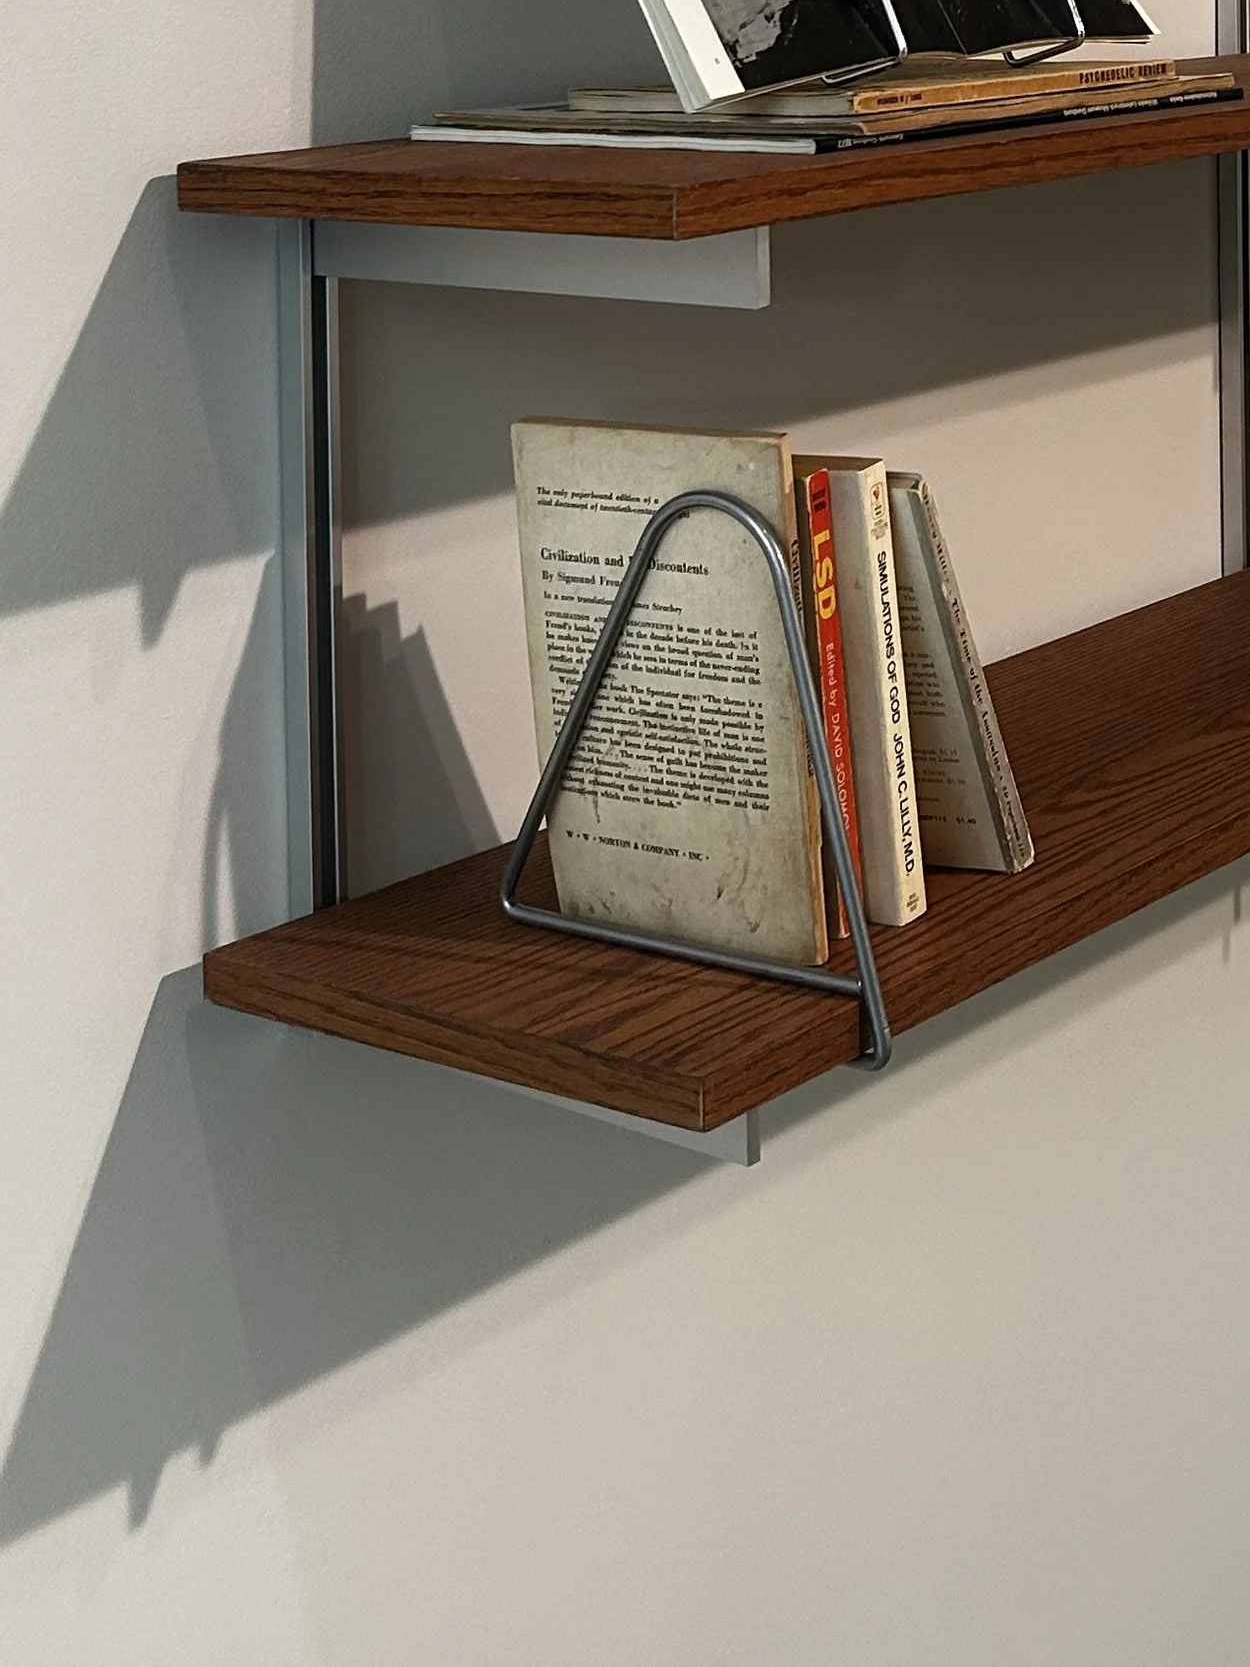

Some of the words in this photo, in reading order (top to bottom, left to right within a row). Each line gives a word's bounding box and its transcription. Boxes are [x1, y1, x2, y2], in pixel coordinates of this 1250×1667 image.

[1138, 63, 1167, 80] REVIEW
[537, 486, 551, 496] The
[540, 547, 600, 565] Civilization
[604, 553, 624, 567] and
[648, 557, 709, 576] Discontents
[813, 529, 837, 620] LSD
[542, 570, 554, 582] By
[557, 571, 596, 587] Sigmund
[877, 550, 895, 660] SIMULATIONS
[951, 597, 961, 624] The
[959, 629, 971, 663] Time
[825, 642, 837, 687] Edited
[886, 660, 898, 684] OF
[969, 667, 979, 682] of
[828, 688, 838, 707] by
[889, 686, 901, 725] GOD
[973, 683, 983, 705] the
[831, 713, 844, 759] DAVID
[893, 733, 906, 780] JOHN
[835, 762, 850, 831] SOLOMO
[899, 797, 913, 843] LILLY,
[599, 836, 631, 849] NORTON
[633, 842, 639, 850] &
[641, 843, 680, 857] COMPANY
[688, 851, 703, 862] INC
